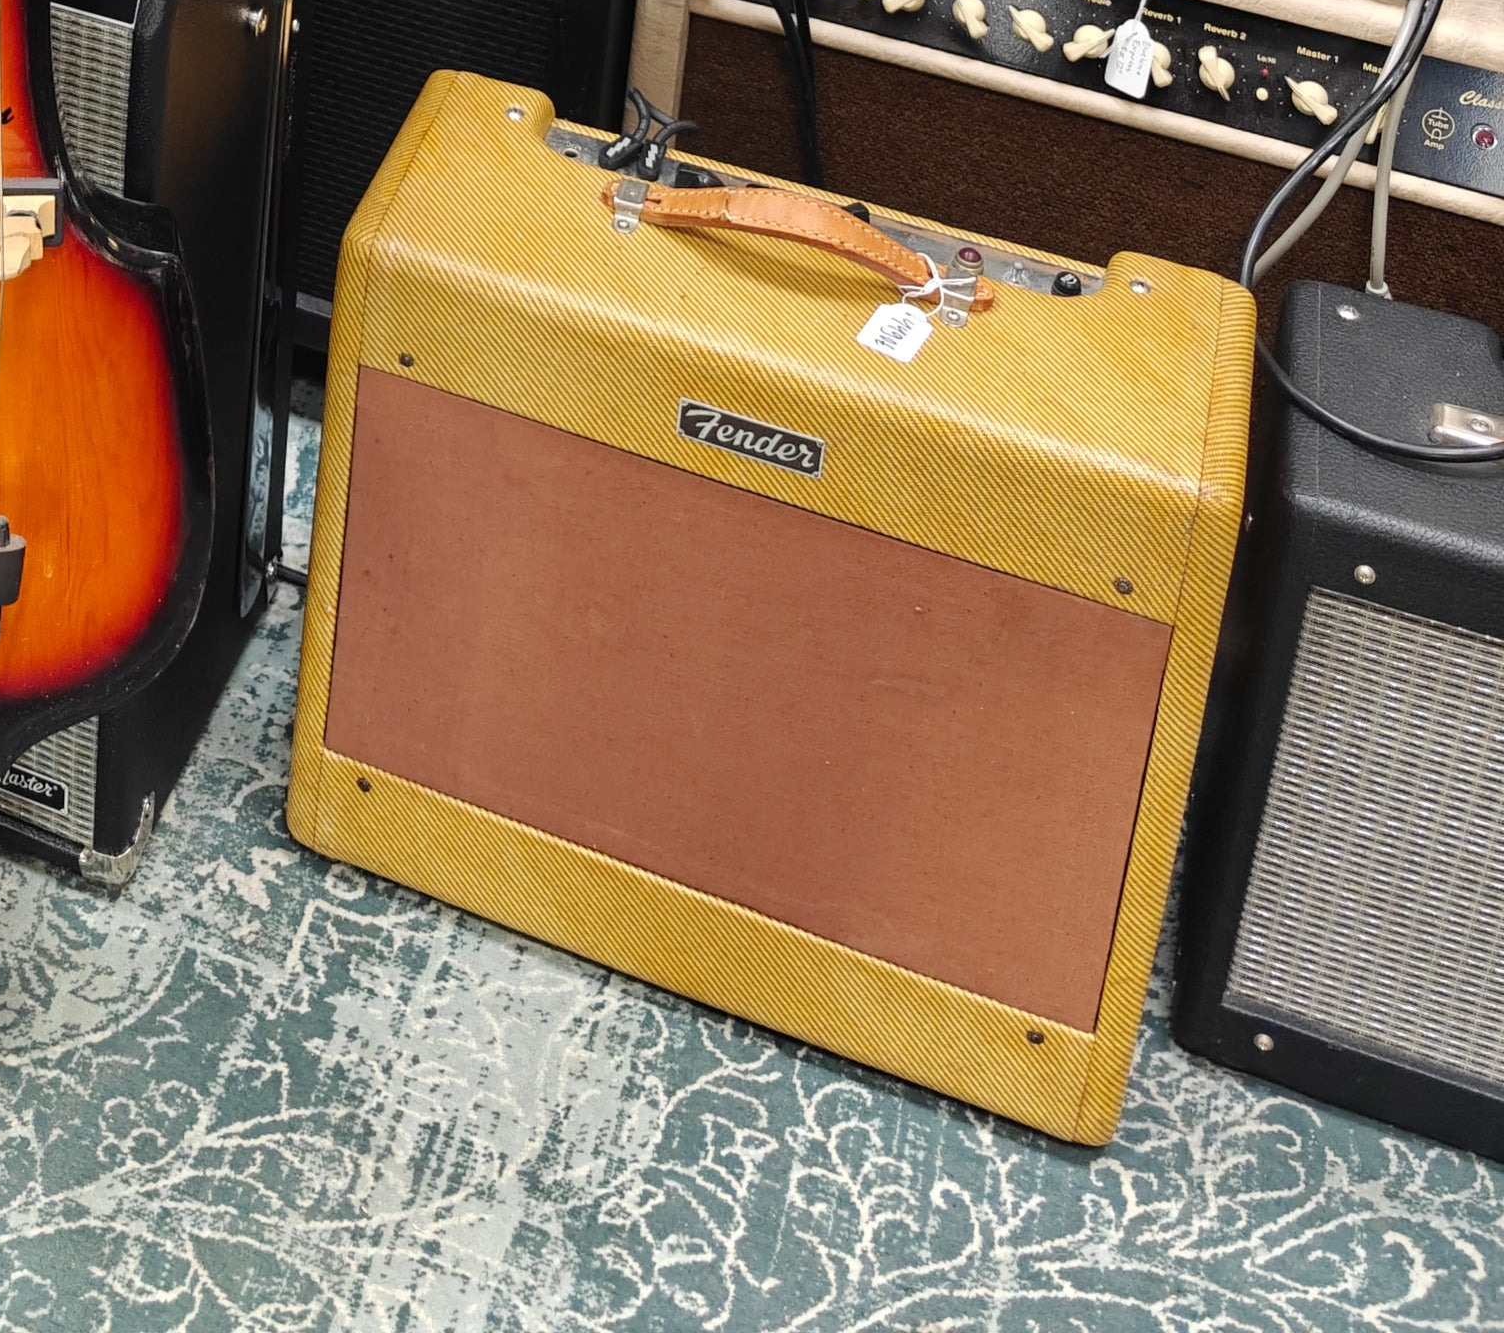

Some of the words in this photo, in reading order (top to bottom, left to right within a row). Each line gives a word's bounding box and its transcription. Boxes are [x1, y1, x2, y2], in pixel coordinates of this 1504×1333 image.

[1141, 8, 1174, 23] Reverb
[1203, 23, 1239, 38] Reverb
[1240, 32, 1247, 41] 2
[1297, 45, 1331, 61] Master
[1362, 62, 1384, 74] Mas
[1427, 119, 1449, 130] Tube
[1424, 139, 1444, 151] Amp
[685, 403, 816, 471] Fender
